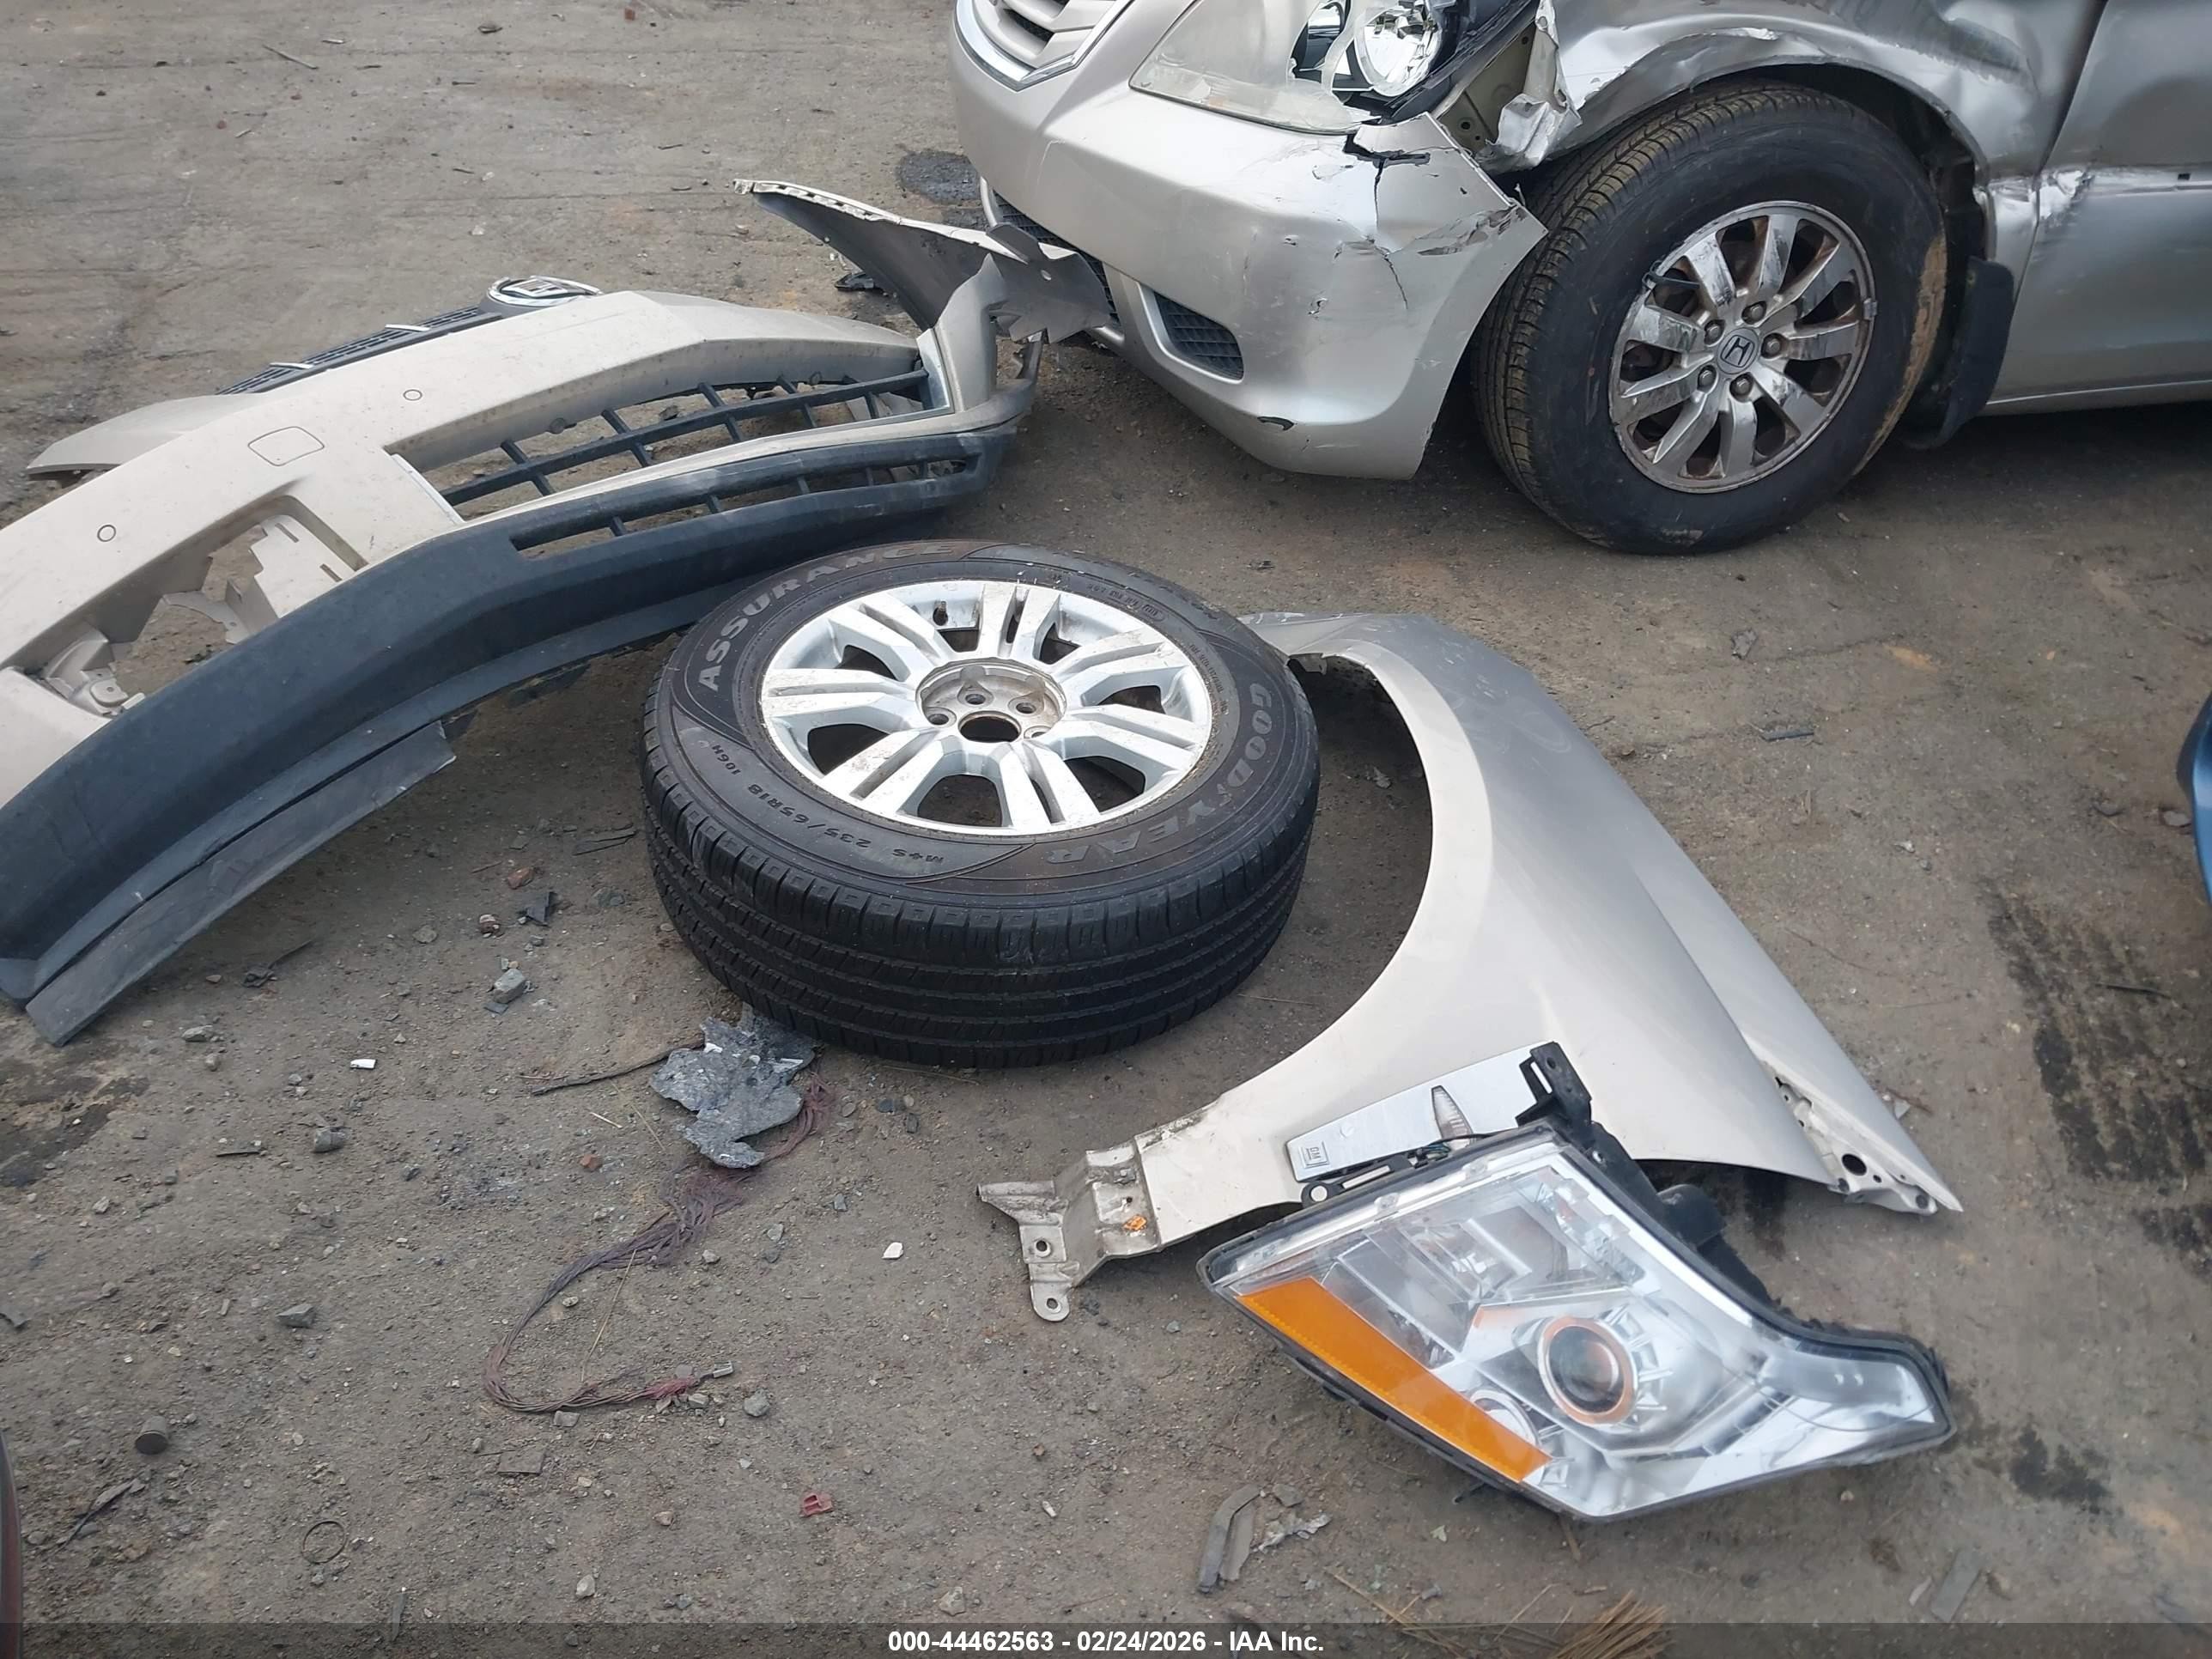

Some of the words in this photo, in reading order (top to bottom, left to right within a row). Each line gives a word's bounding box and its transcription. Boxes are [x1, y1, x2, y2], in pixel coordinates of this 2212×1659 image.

[698, 544, 952, 691] ASSURANCE
[711, 744, 741, 775] 106H
[1045, 683, 1273, 864] GOODYEAR
[747, 783, 872, 848] 235/65R18
